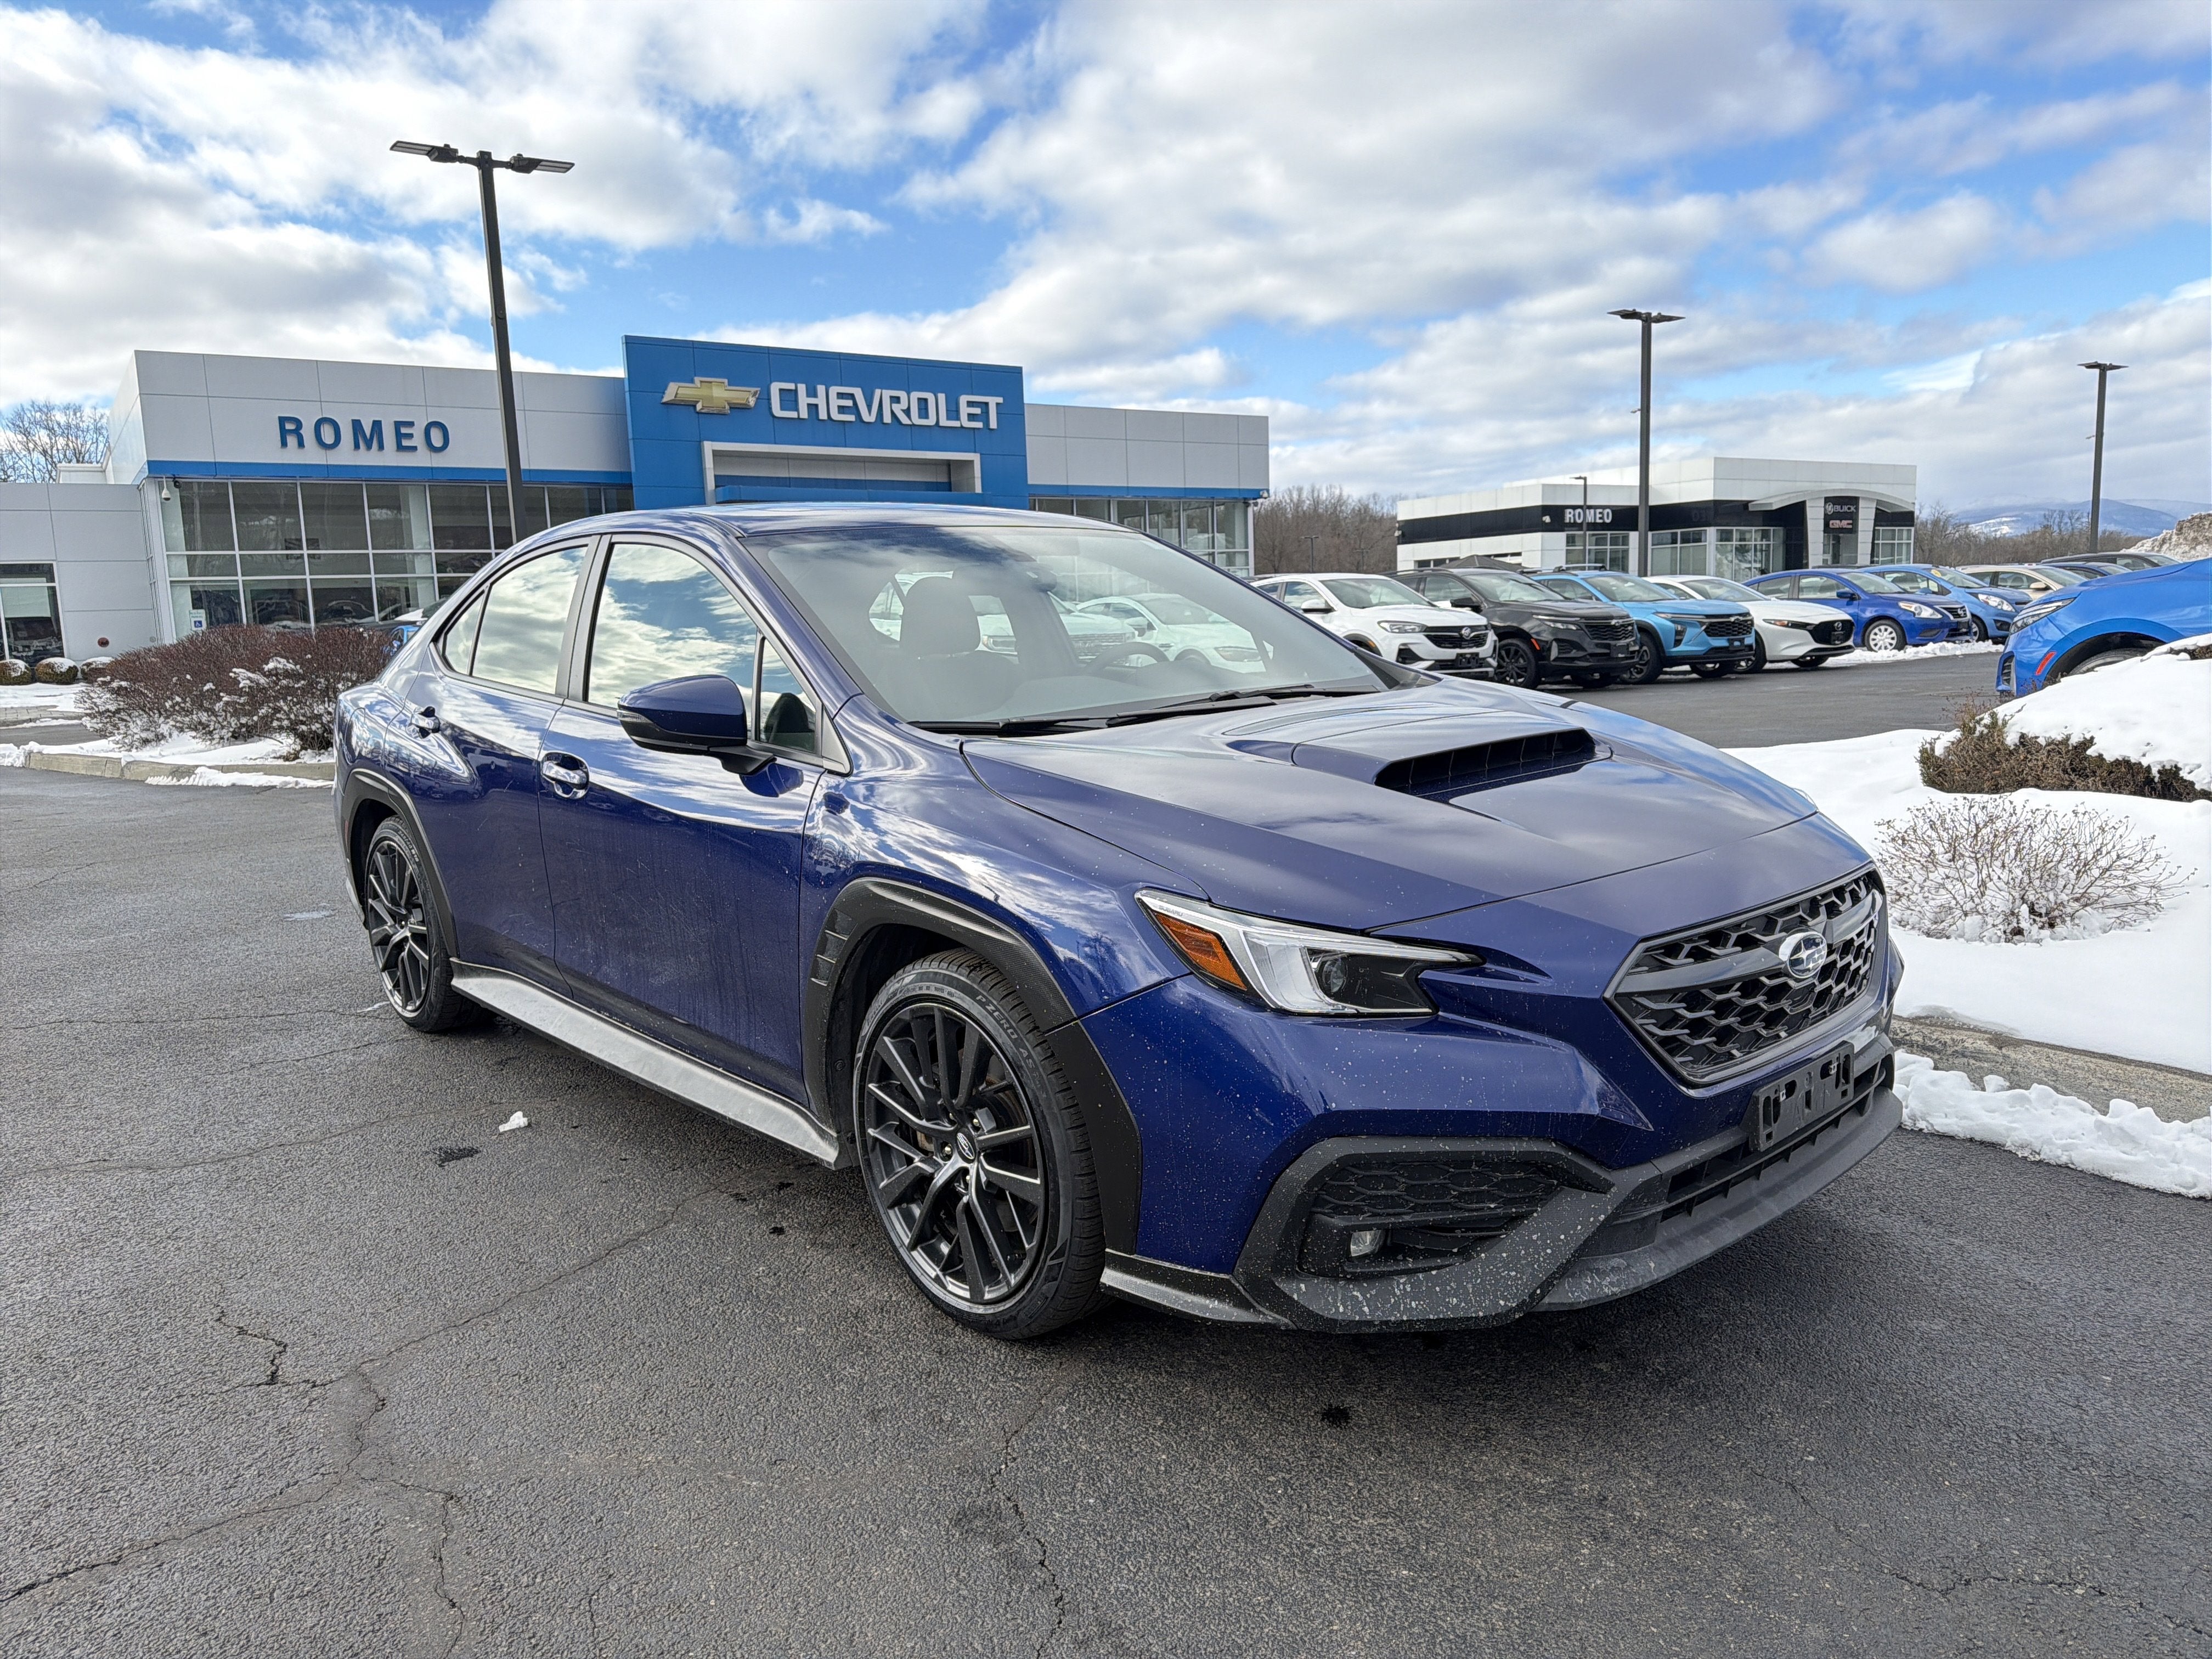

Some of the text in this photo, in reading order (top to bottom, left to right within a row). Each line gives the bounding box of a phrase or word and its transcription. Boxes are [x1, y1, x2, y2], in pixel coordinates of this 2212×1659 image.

[770, 382, 1003, 429] CHEVROLET
[278, 416, 450, 453] ROMEO
[1565, 508, 1612, 523] ROMEO
[1829, 520, 1853, 528] GMC
[985, 1003, 1018, 1039] ZERO
[1019, 1048, 1035, 1068] AS
